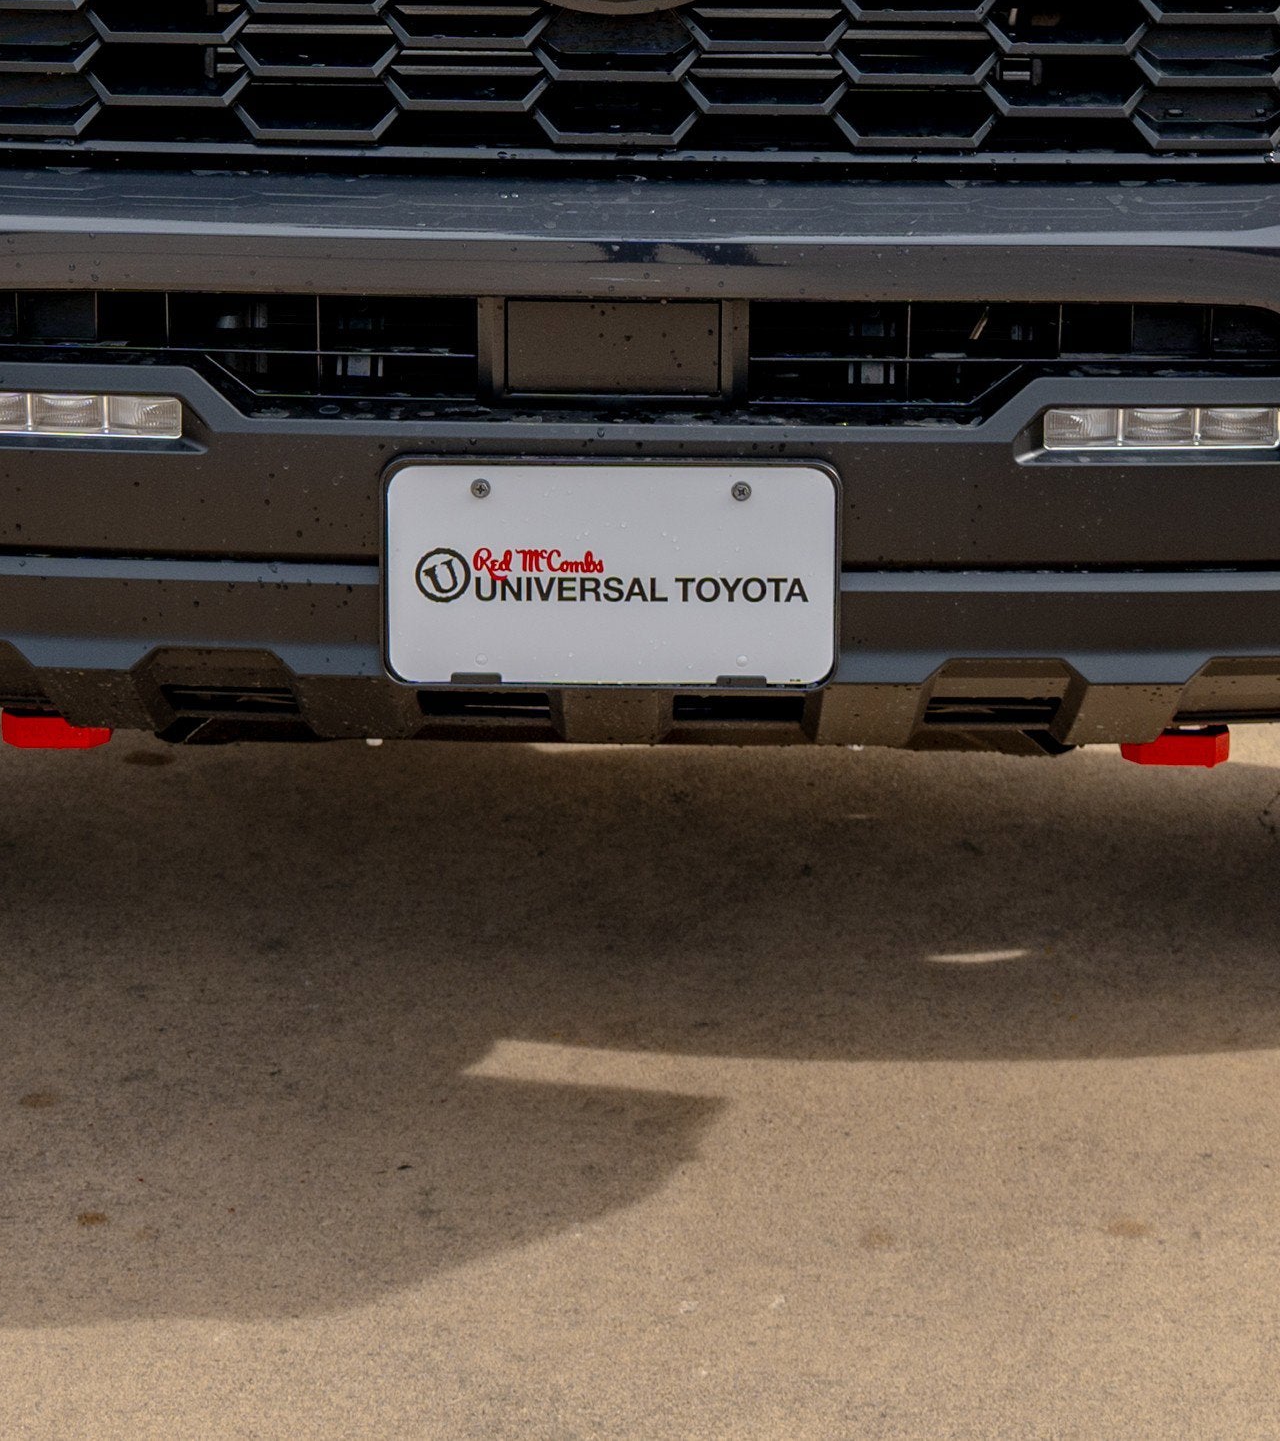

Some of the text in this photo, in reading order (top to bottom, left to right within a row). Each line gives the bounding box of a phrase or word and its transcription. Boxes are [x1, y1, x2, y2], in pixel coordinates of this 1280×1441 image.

[473, 547, 605, 581] Red McCombs
[475, 576, 809, 603] UNIVERSAL TOYOTA
